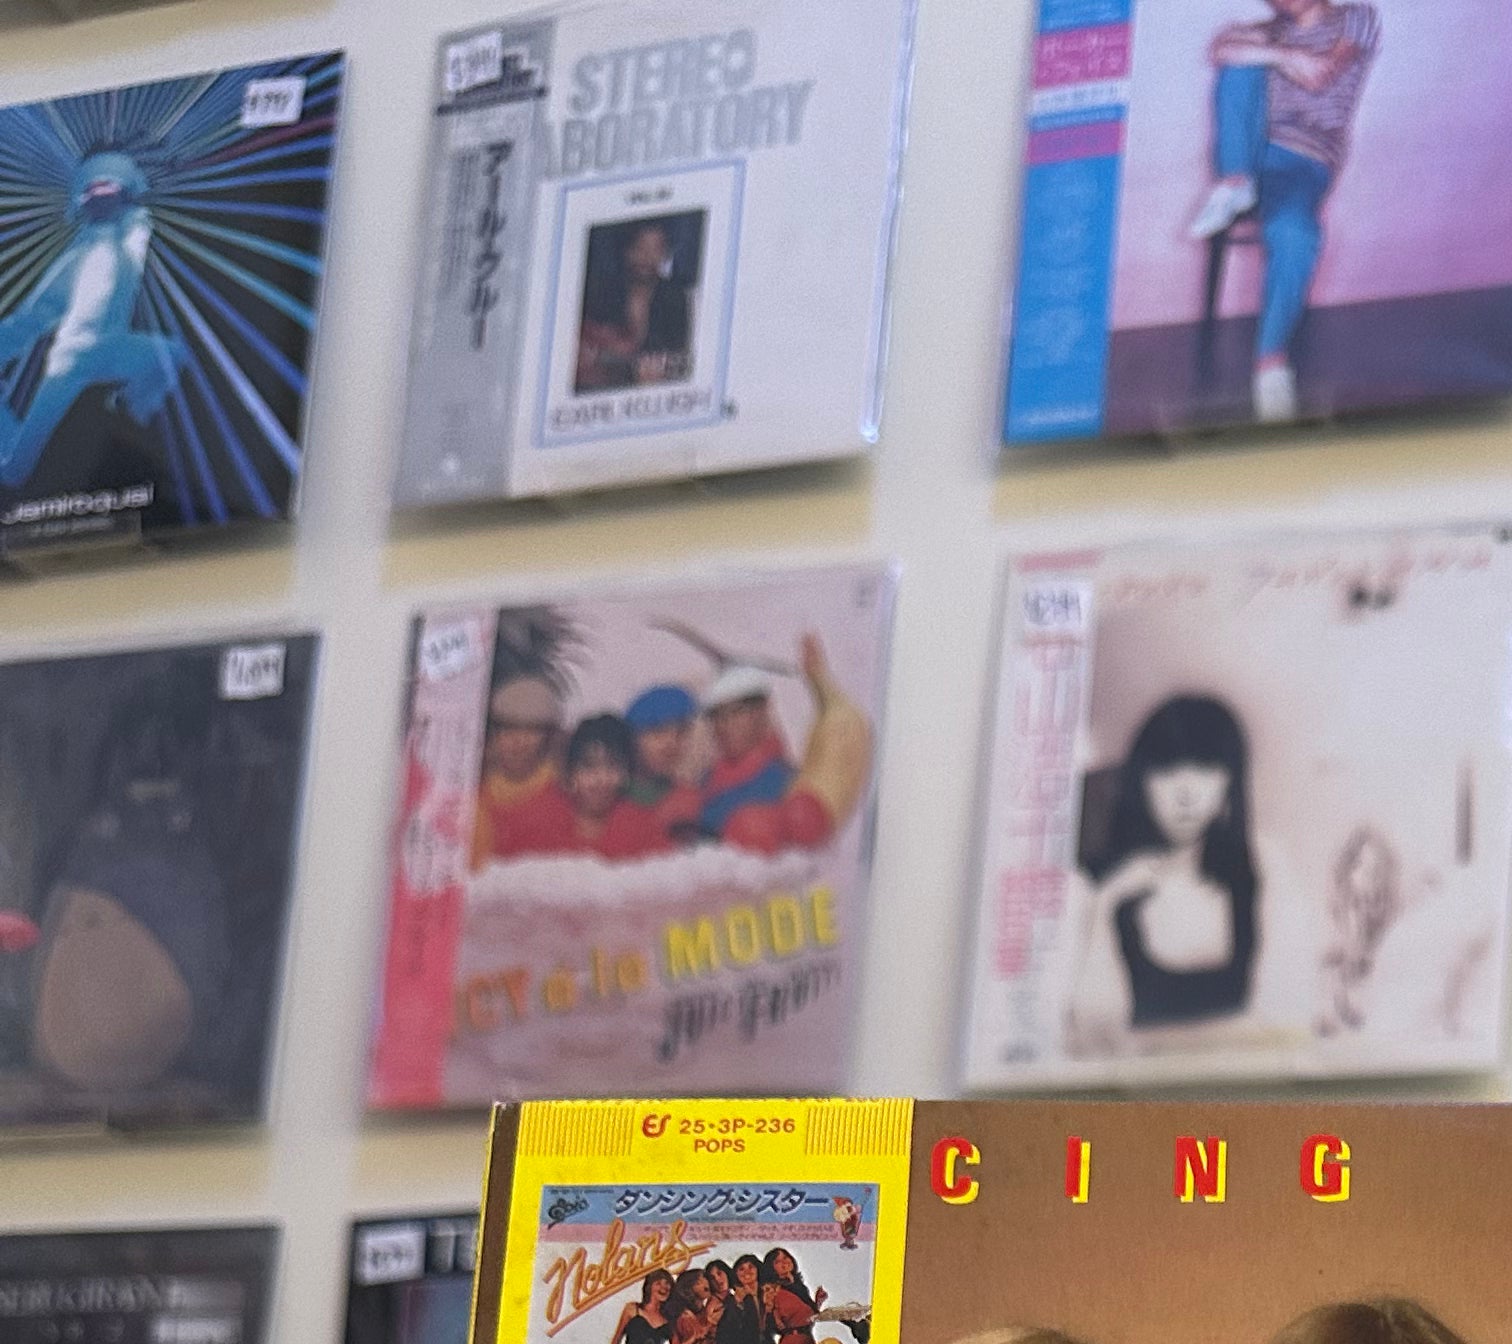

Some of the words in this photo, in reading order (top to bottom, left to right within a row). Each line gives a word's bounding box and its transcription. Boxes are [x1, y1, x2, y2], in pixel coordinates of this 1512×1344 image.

[570, 28, 757, 113] STEREO
[544, 79, 816, 178] ABORATORY
[667, 886, 841, 981] MODE
[694, 1138, 746, 1153] POPS
[930, 1135, 1351, 1204] CING
[542, 1218, 718, 1338] Nolans
